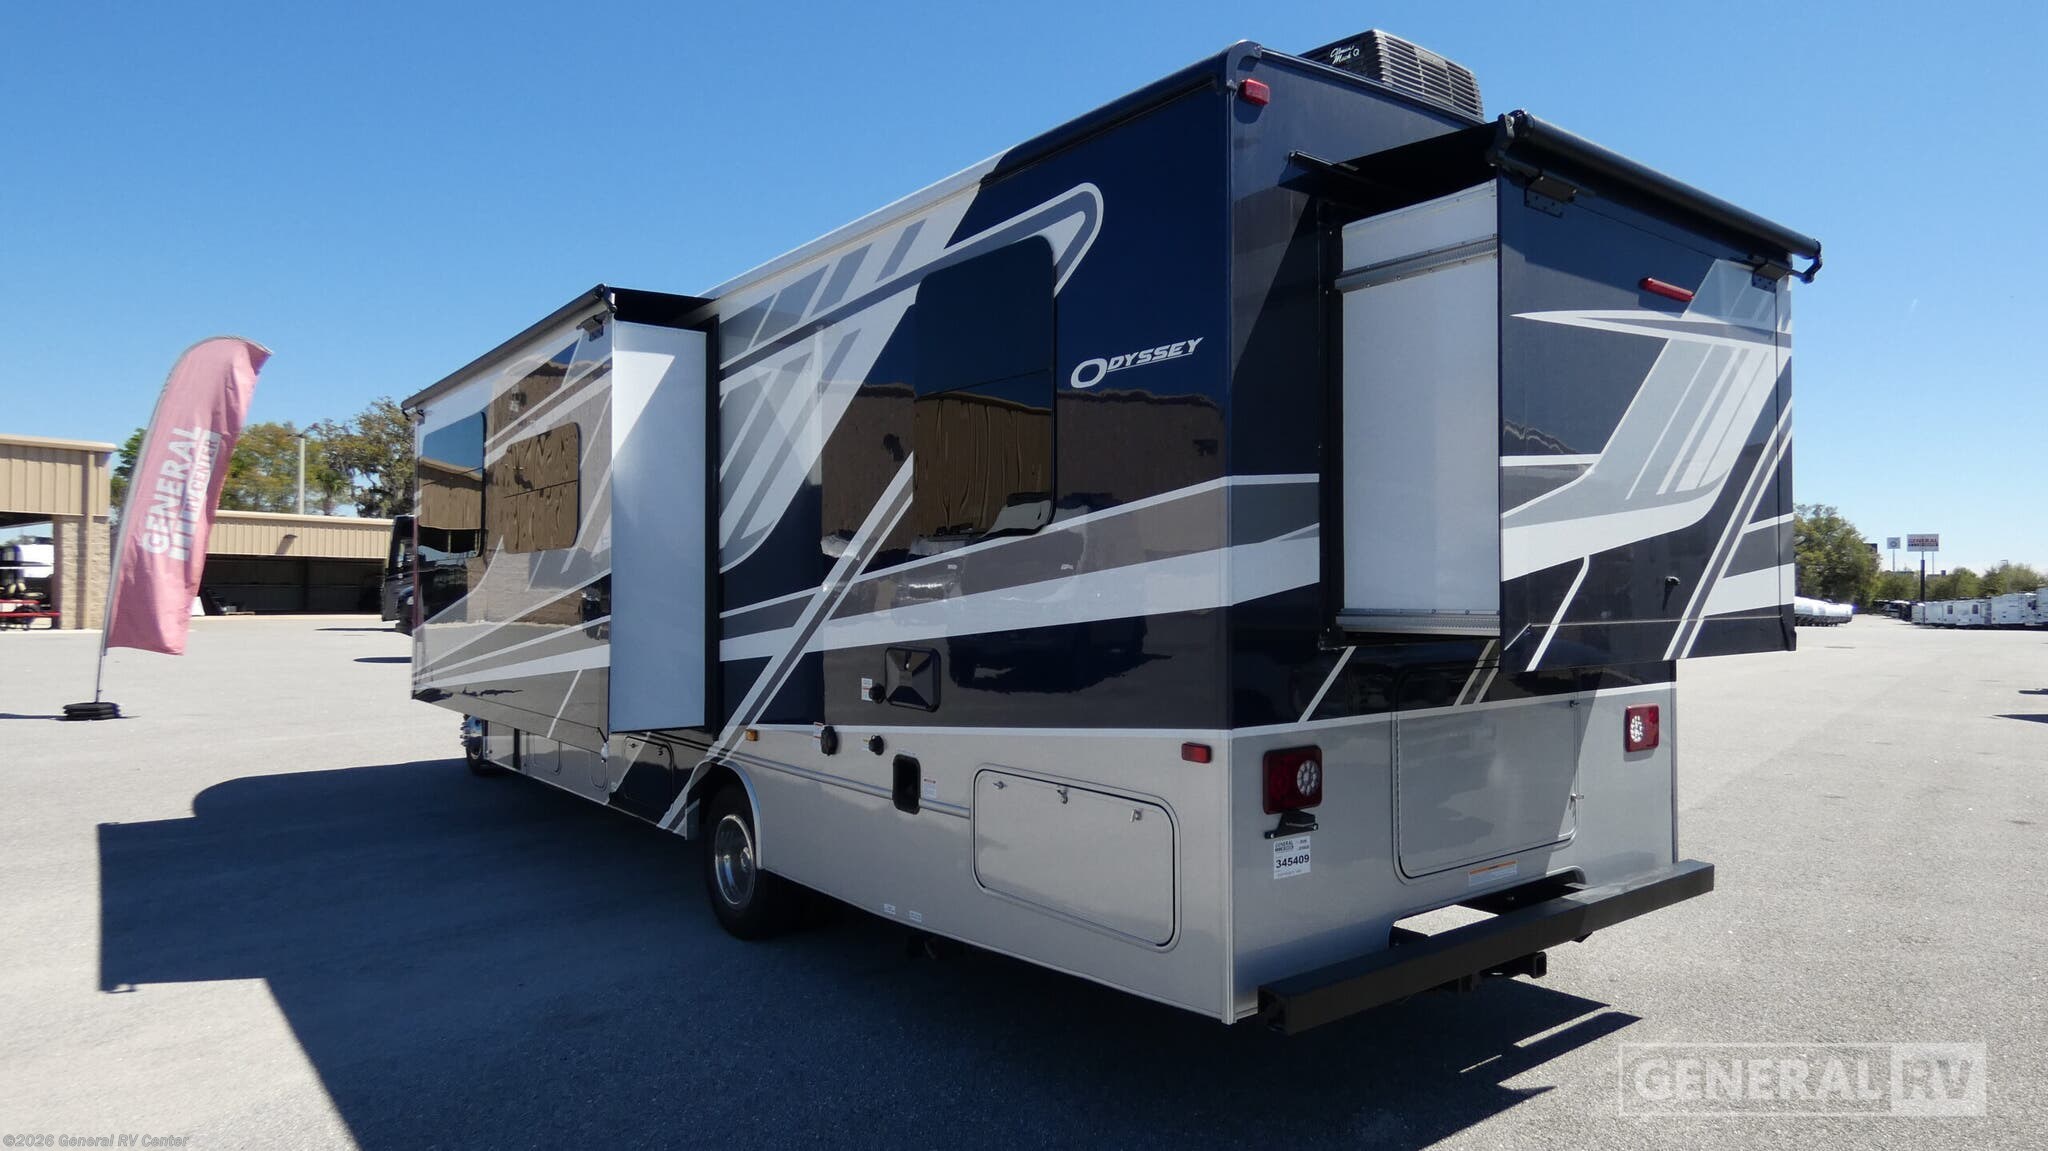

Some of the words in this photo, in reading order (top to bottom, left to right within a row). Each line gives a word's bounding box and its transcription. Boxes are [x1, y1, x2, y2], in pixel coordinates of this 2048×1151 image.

[141, 426, 202, 554] GENERAL
[191, 440, 218, 497] CENTER
[1276, 854, 1310, 869] 345409
